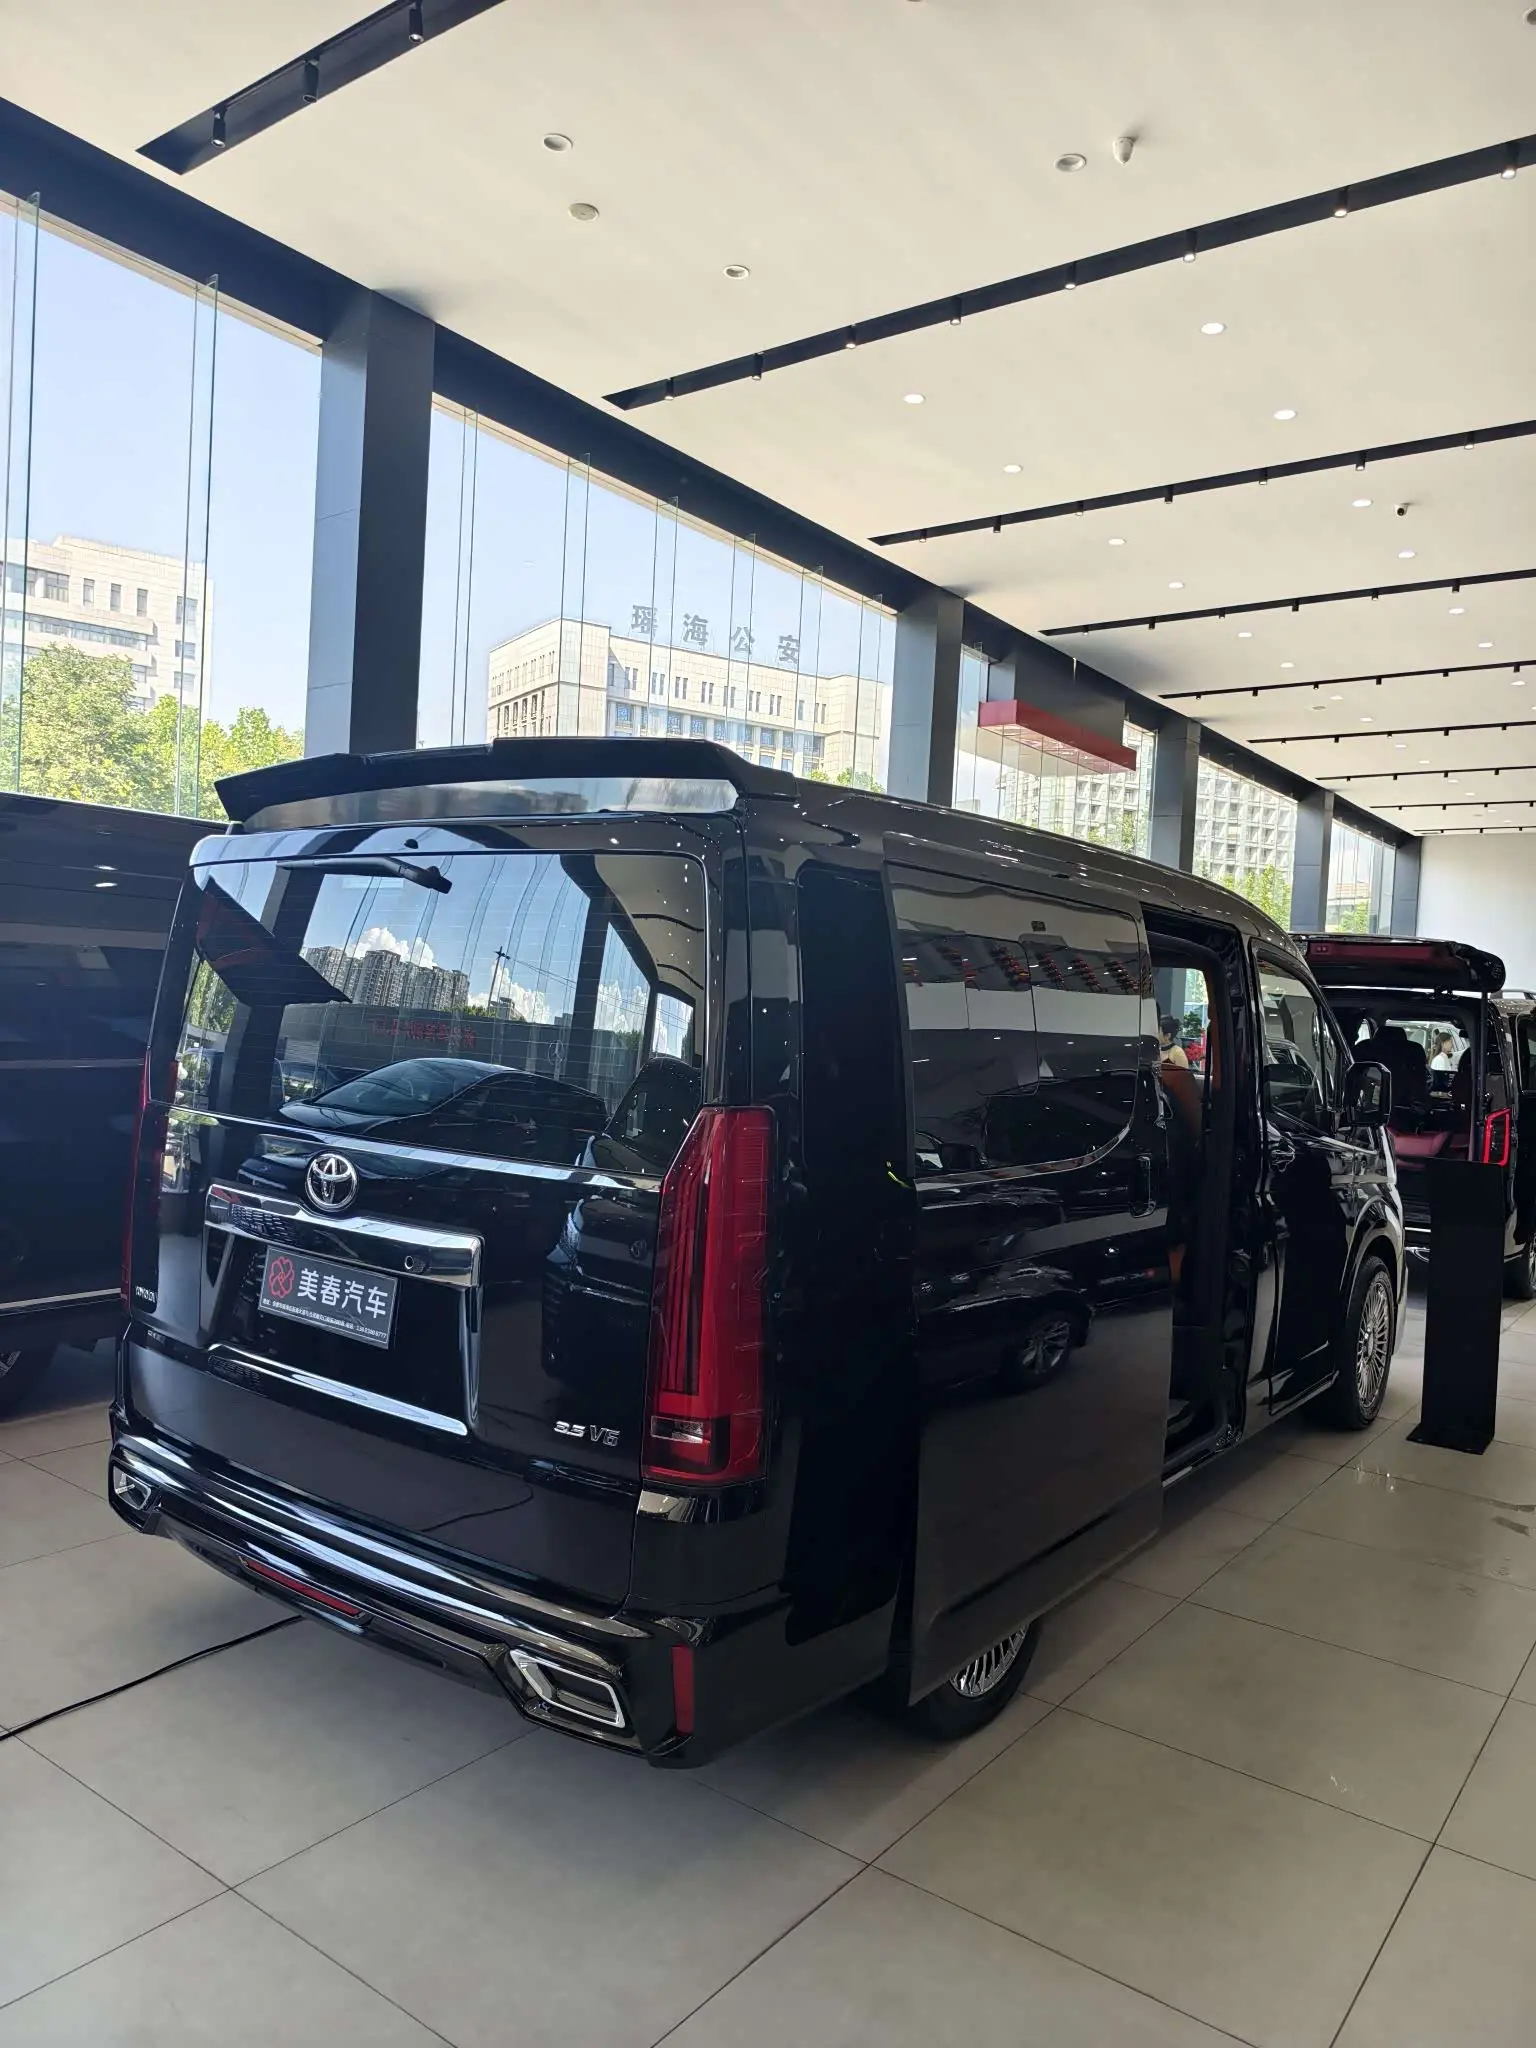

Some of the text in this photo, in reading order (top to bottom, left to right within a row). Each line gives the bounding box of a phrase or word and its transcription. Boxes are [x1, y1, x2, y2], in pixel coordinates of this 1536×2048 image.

[631, 604, 801, 664] 瑶海公安
[297, 1268, 388, 1319] 美春汽车
[589, 1424, 621, 1447] V6
